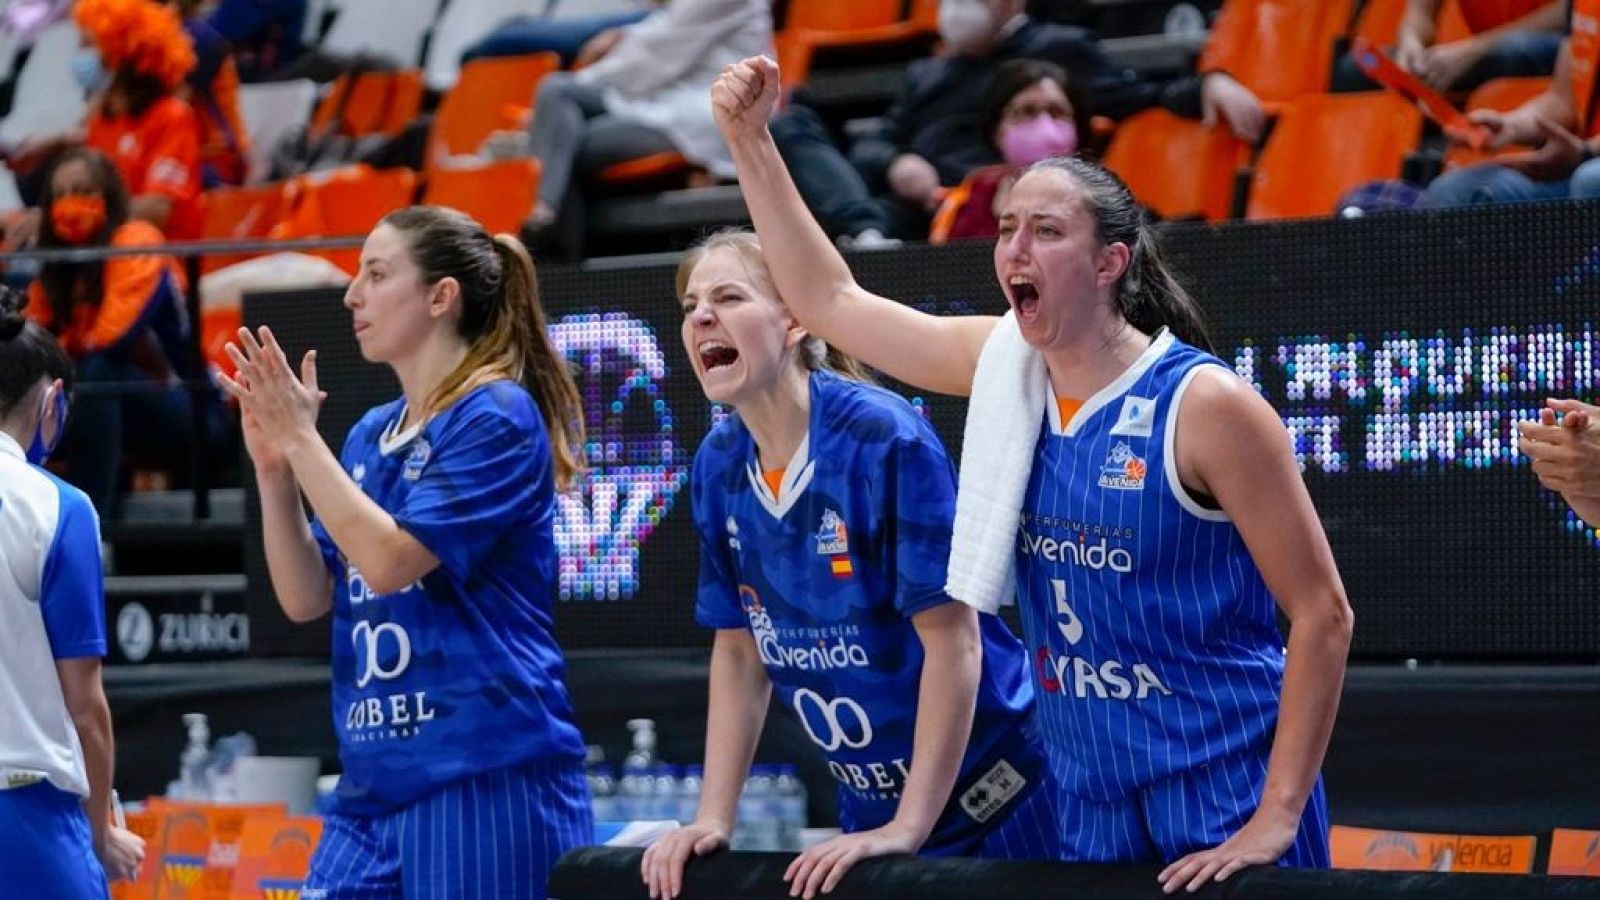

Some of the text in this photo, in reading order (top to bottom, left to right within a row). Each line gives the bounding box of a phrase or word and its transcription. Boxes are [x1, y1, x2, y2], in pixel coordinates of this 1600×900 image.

[1051, 579, 1083, 645] 5
[761, 637, 869, 670] avenida
[1036, 645, 1173, 699] CYRSA
